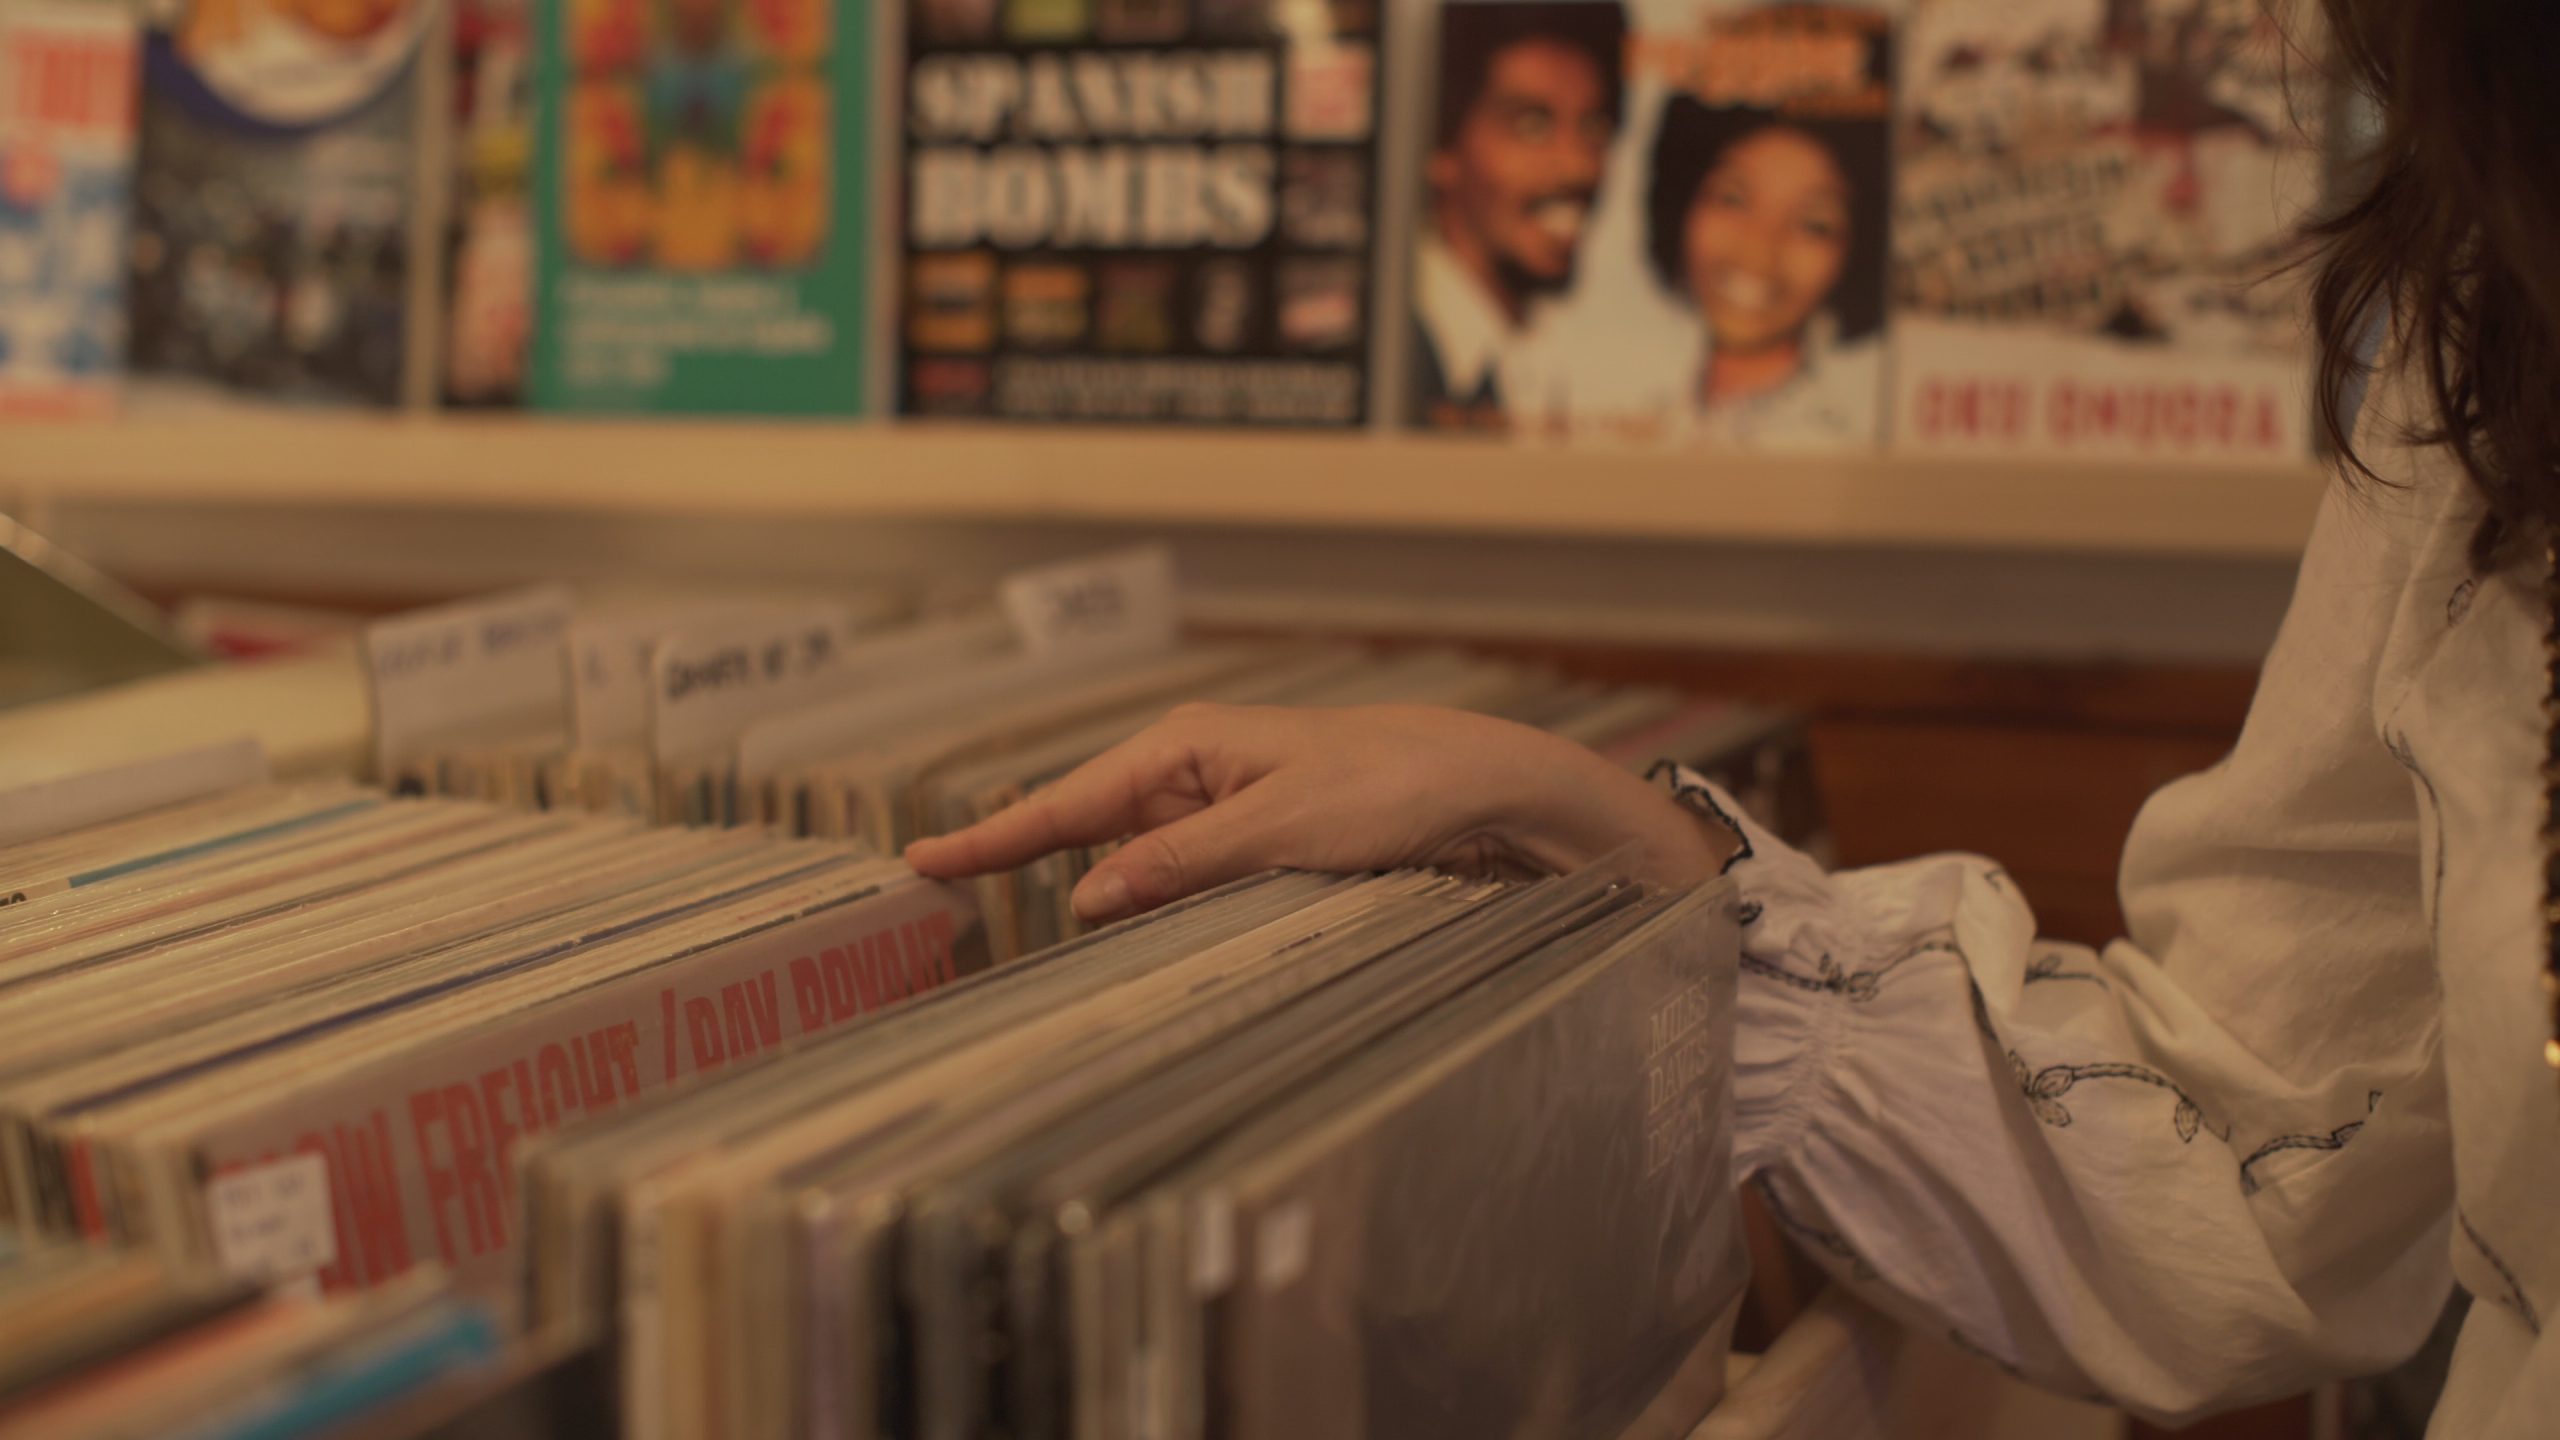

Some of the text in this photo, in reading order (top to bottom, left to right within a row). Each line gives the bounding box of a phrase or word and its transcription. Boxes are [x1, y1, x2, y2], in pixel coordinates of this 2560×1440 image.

[912, 50, 1277, 140] SPANISH
[910, 145, 1277, 248] BOMBS
[1648, 976, 1709, 1058] MILES
[1648, 1028, 1710, 1116] DAVIS
